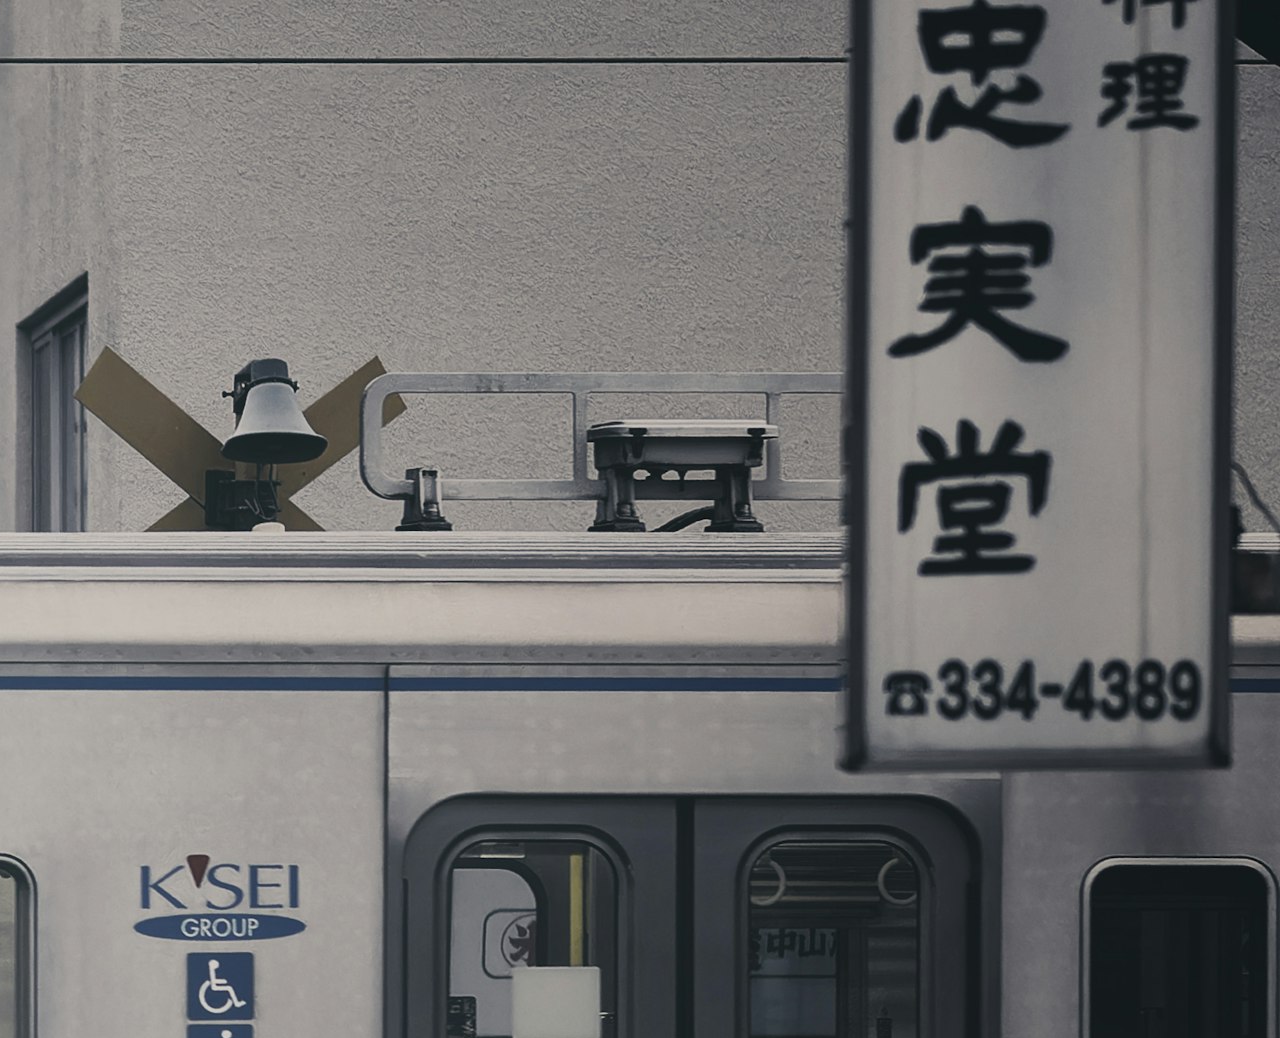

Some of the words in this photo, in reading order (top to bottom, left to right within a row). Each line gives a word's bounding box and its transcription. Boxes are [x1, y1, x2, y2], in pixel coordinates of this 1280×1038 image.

[1097, 0, 1200, 132] 理
[887, 0, 1071, 576] 忠実堂
[937, 658, 1203, 722] 334-4389
[180, 918, 260, 938] GROUP
